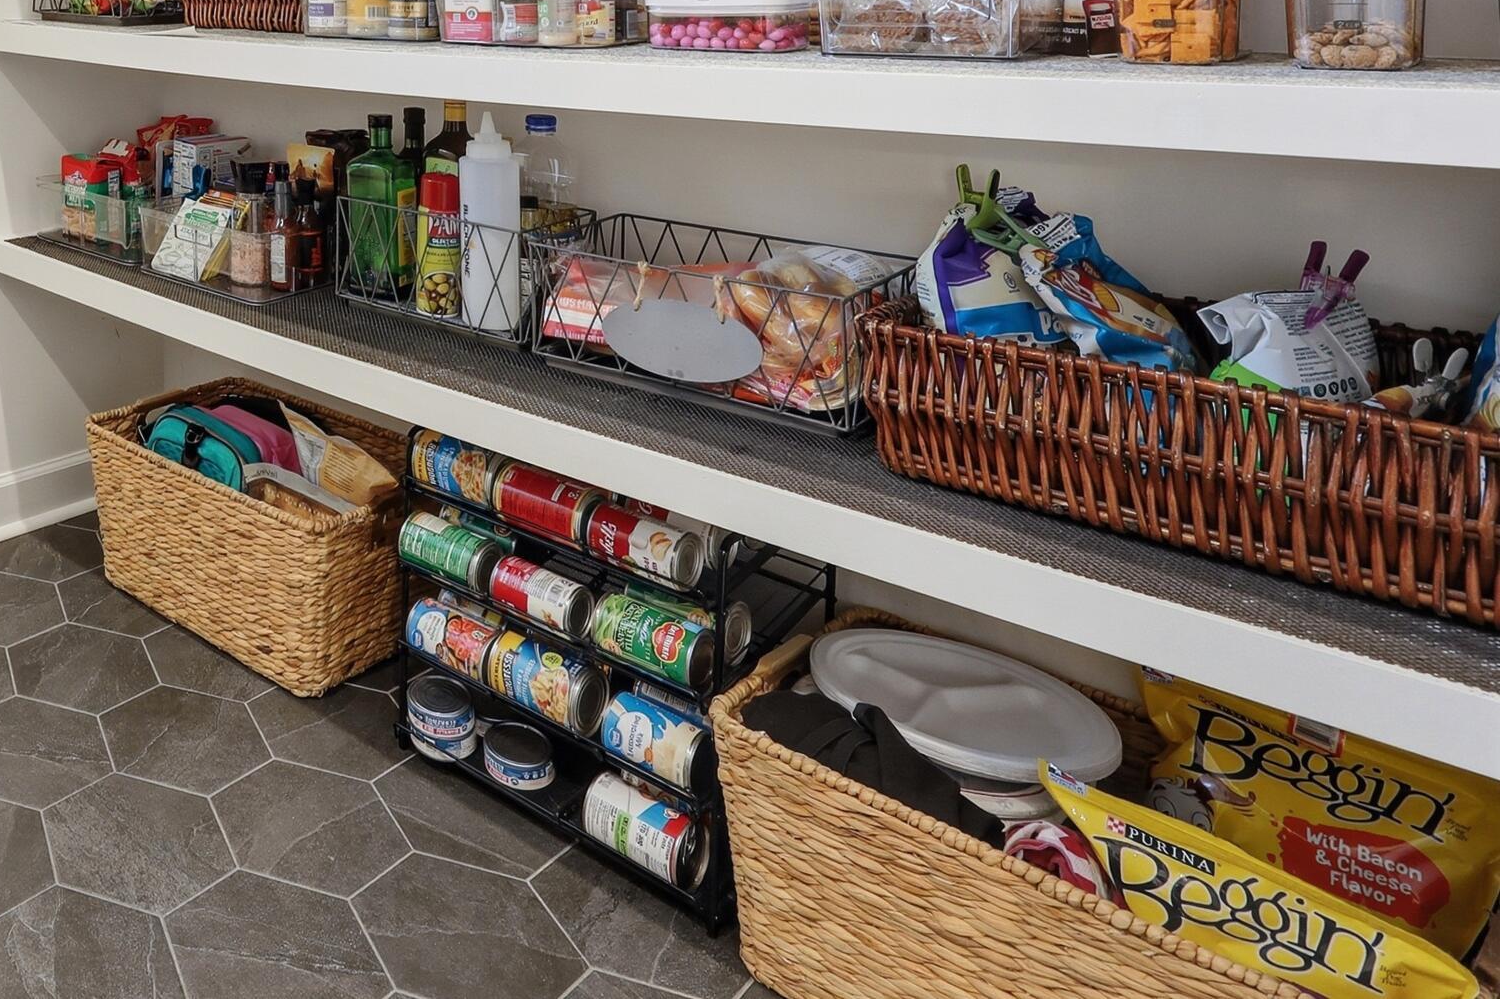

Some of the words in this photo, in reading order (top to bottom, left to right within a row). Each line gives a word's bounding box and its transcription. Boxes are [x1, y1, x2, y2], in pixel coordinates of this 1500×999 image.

[462, 203, 471, 278] BLACKSTONE
[1180, 703, 1456, 844] Beggin'
[1129, 826, 1212, 875] PURINA
[1305, 826, 1351, 856] With
[1357, 843, 1423, 882] Bacon
[1315, 848, 1332, 866] &
[1337, 854, 1413, 895] Cheese
[1093, 835, 1385, 996] Beggin'
[1330, 872, 1396, 907] Flavor
